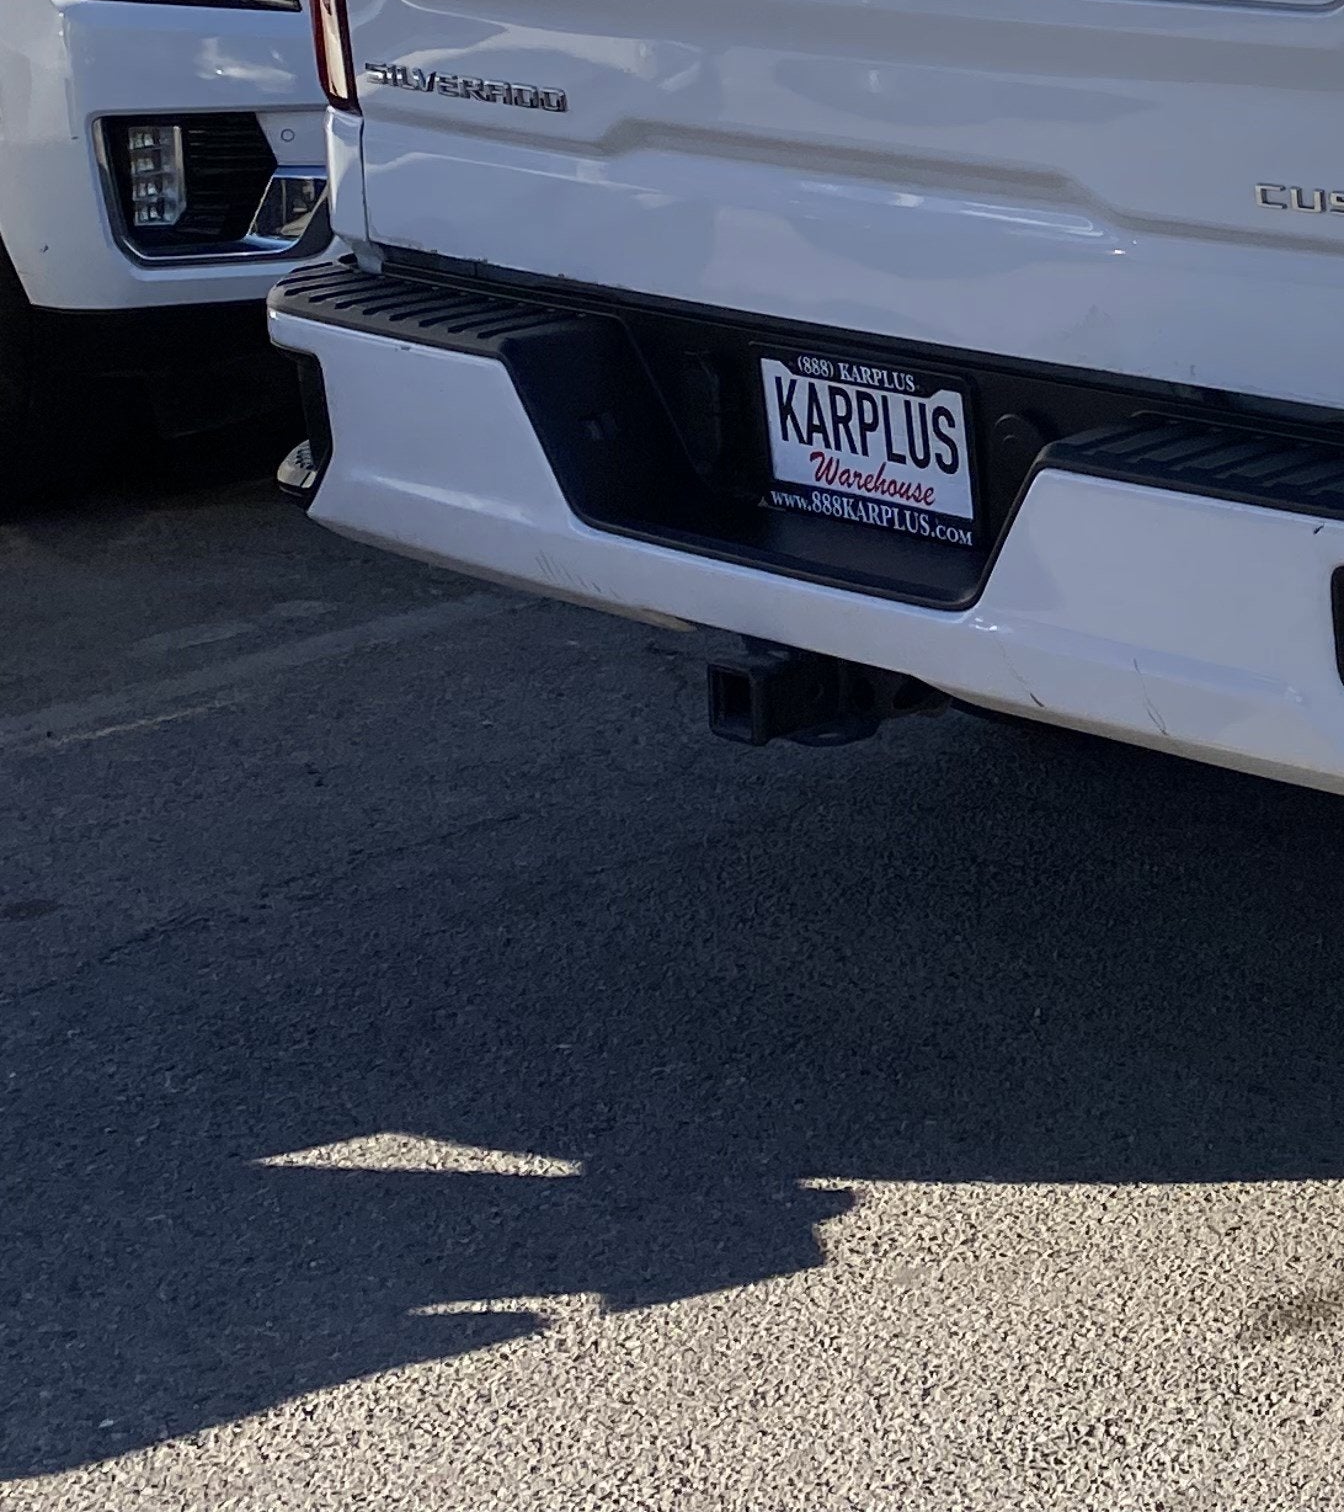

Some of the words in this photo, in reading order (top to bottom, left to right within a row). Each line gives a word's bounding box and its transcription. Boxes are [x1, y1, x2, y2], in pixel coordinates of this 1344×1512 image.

[364, 62, 568, 113] SILVERADO
[797, 355, 834, 377] (888)
[839, 362, 916, 392] KARPLUS
[775, 375, 959, 475] KARPLUS
[810, 451, 936, 506] Warehouse
